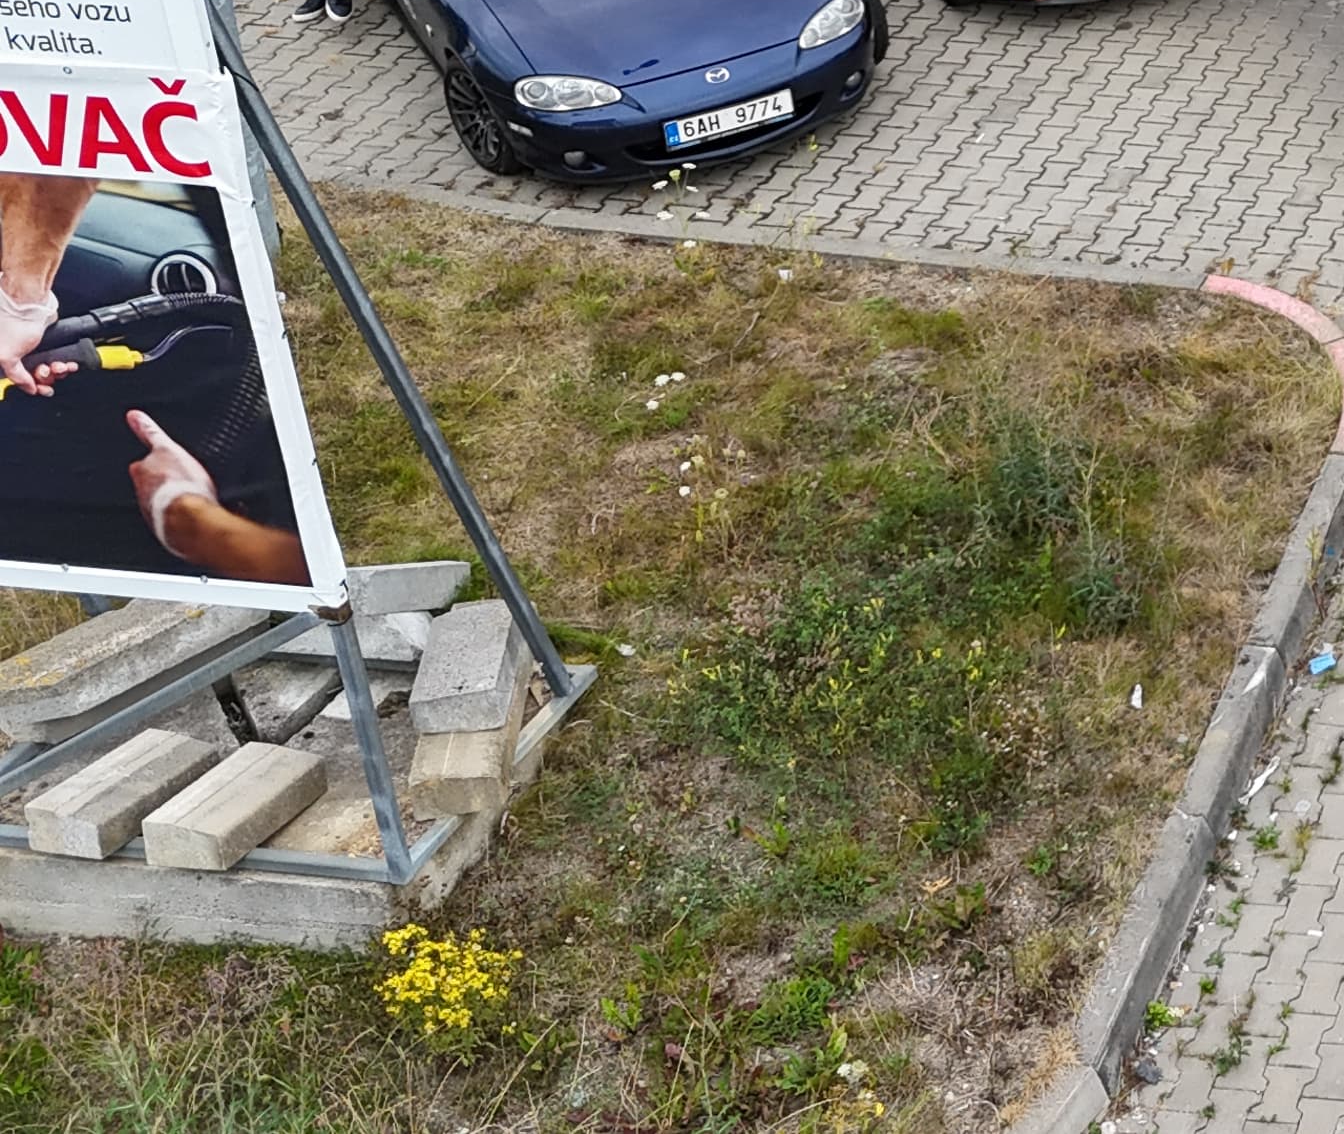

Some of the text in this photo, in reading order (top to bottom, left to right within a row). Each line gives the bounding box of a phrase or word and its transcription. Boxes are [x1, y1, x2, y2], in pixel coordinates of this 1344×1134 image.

[67, 2, 132, 23] vozu
[4, 26, 103, 55] kvalita.
[0, 76, 213, 179] VAČ
[683, 115, 721, 138] 6AH
[735, 96, 783, 124] 9774
